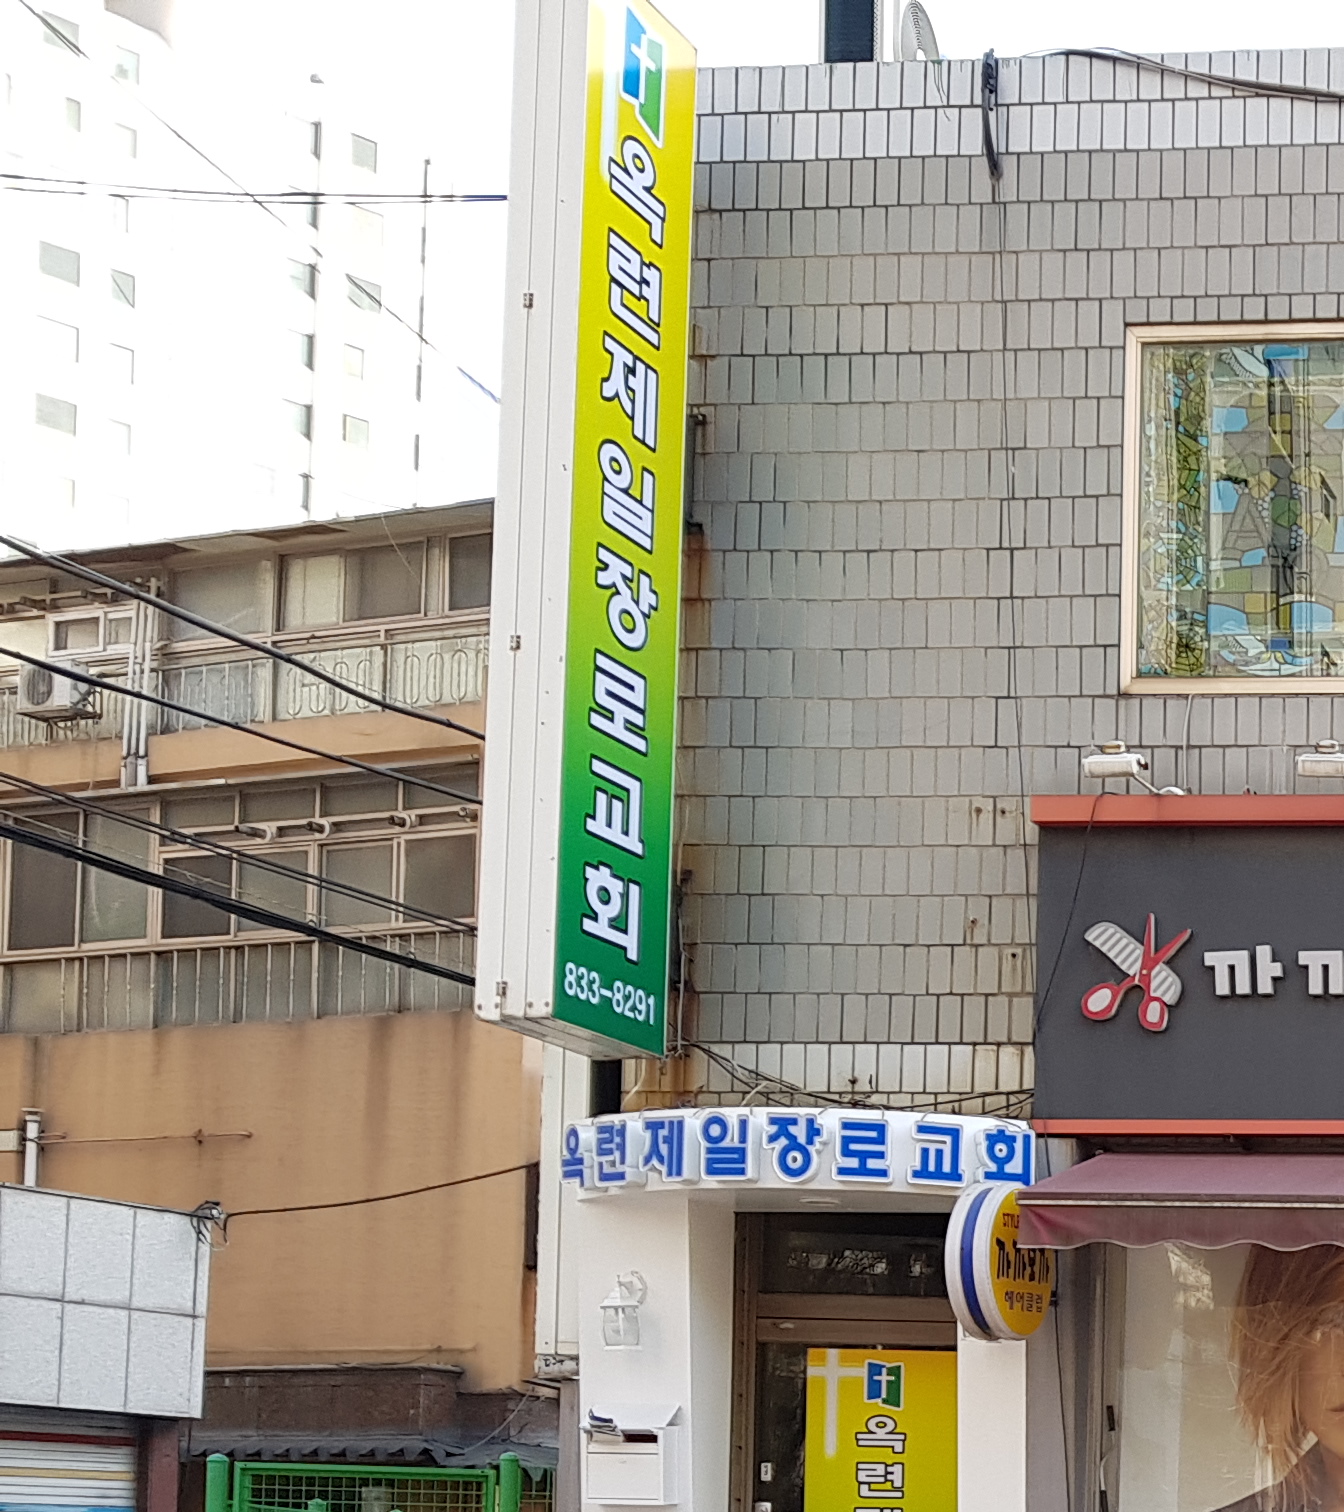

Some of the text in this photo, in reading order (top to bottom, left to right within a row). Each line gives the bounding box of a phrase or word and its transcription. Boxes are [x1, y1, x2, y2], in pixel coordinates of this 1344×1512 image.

[581, 131, 665, 962] 옥련제일장로교회
[563, 961, 656, 1028] 833-8291
[561, 1112, 1031, 1188] 옥련제일장로교회
